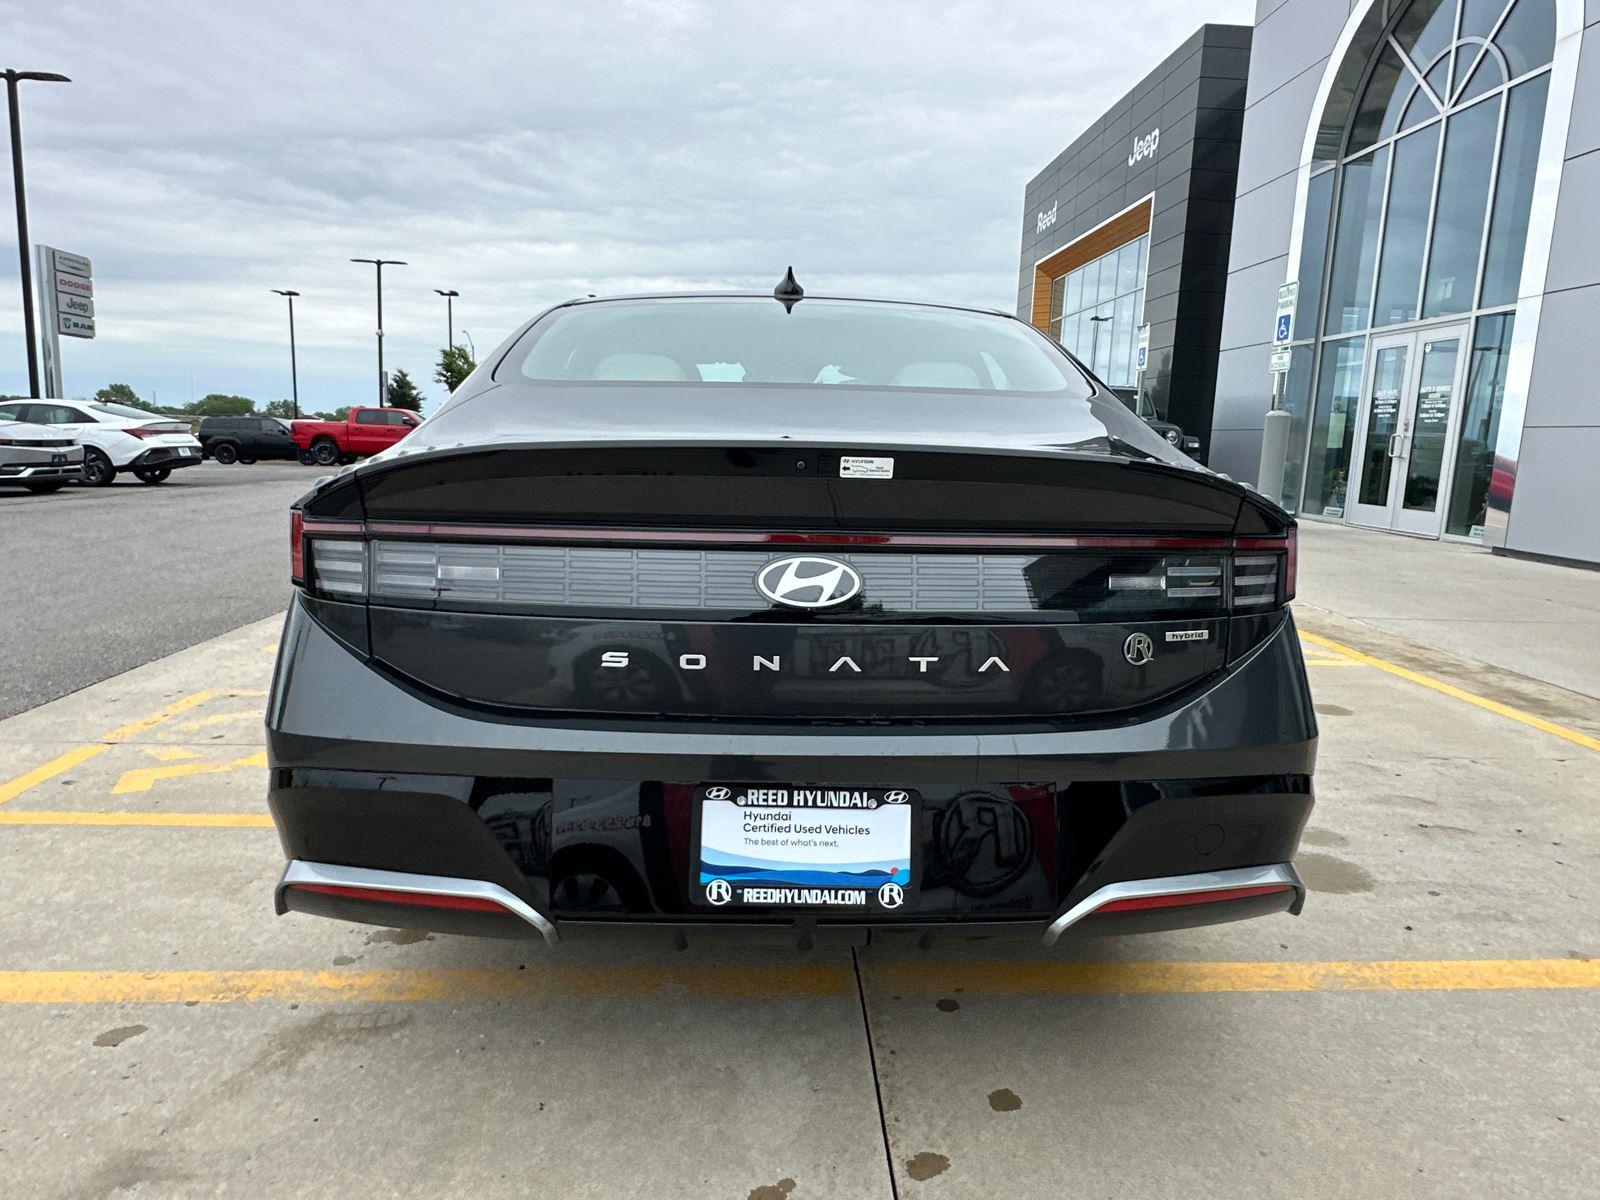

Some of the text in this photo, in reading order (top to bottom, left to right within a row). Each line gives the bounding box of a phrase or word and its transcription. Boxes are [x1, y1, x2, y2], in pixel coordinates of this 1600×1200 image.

[1128, 128, 1160, 167] Jeep
[1036, 200, 1058, 235] Reed
[59, 279, 92, 291] DODGE
[66, 296, 89, 314] Jeep
[73, 321, 94, 332] RAM
[1172, 631, 1204, 640] hybrid
[600, 651, 1010, 672] SONATA
[747, 788, 868, 808] REED HYUNDAI
[743, 811, 792, 822] Hyundai
[743, 823, 871, 835] Certified Used Vehicles
[761, 838, 779, 846] best
[780, 838, 790, 846] of
[791, 839, 818, 847] what's
[743, 888, 866, 905] REEDHYUNDAI.COM
